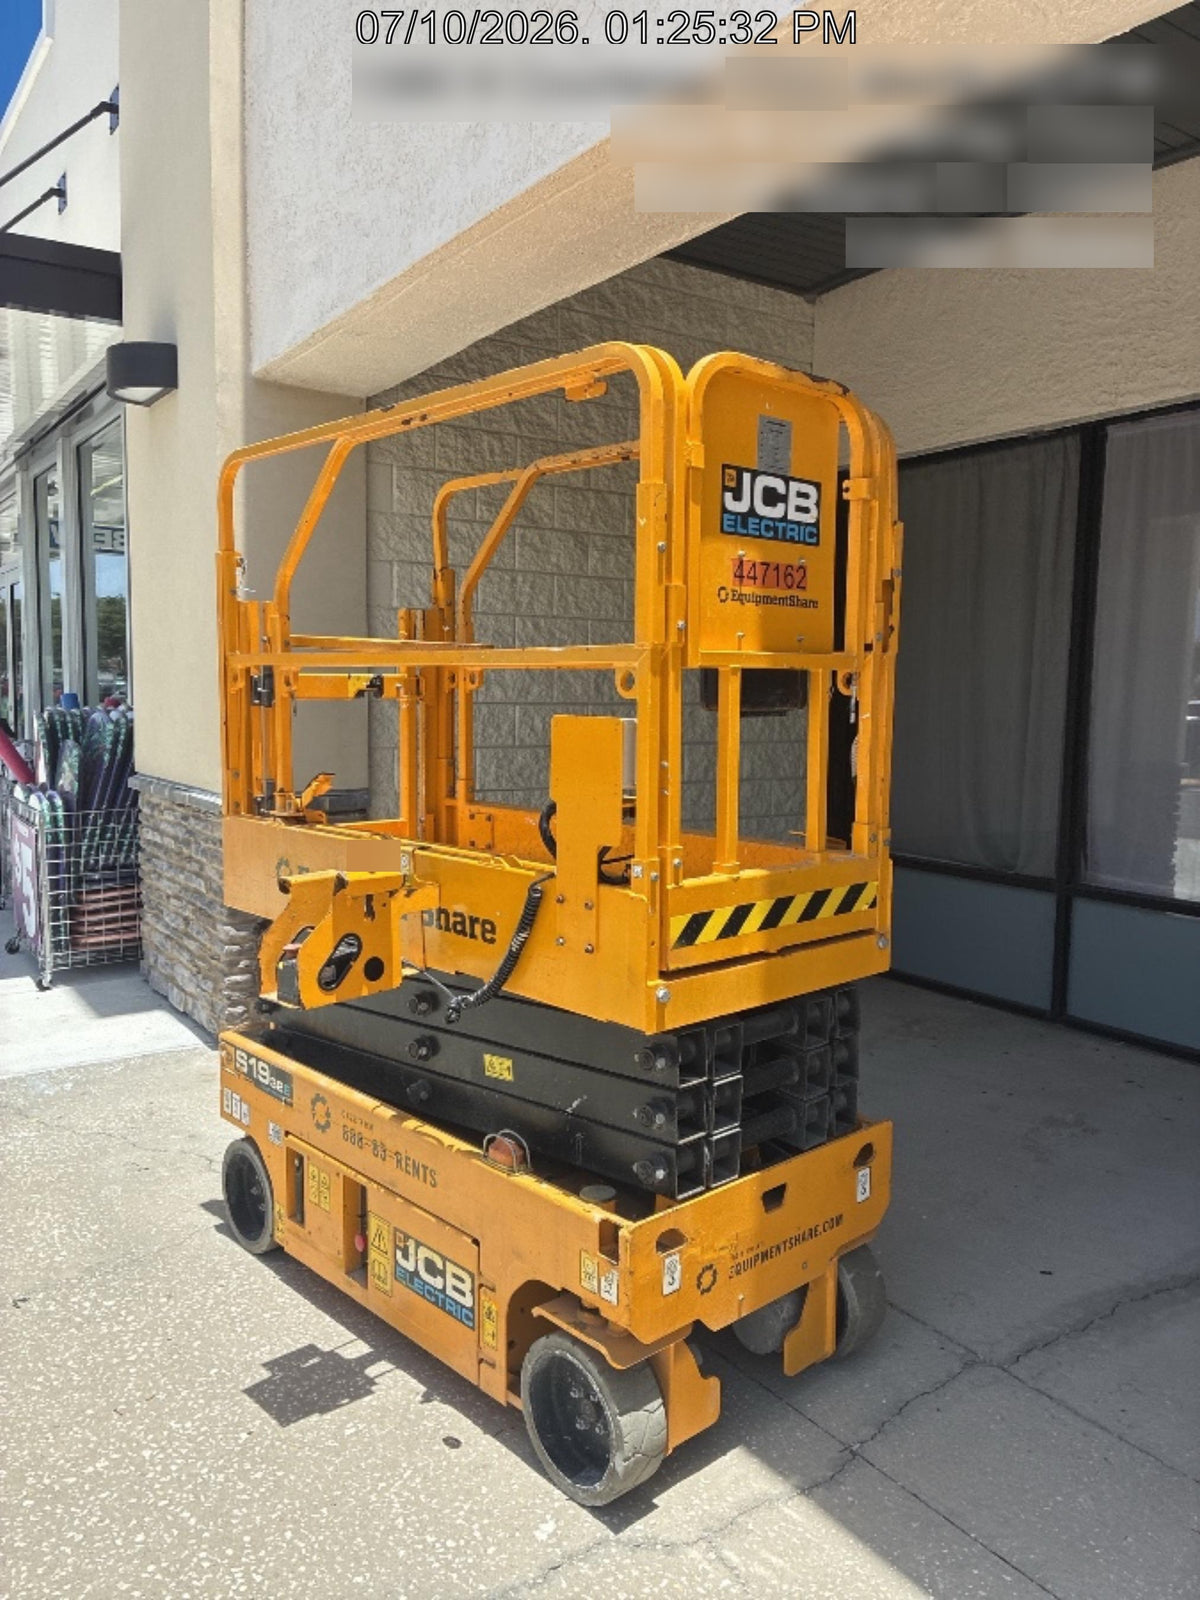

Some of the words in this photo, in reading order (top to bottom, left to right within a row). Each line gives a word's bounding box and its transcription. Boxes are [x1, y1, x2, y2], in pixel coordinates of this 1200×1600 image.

[723, 471, 819, 524] JCB
[722, 513, 818, 543] ELECTRIC
[734, 559, 807, 590] 447162
[730, 588, 819, 608] EquipmentShare
[395, 1238, 474, 1308] JCB
[395, 1264, 474, 1328] ELECTRIC
